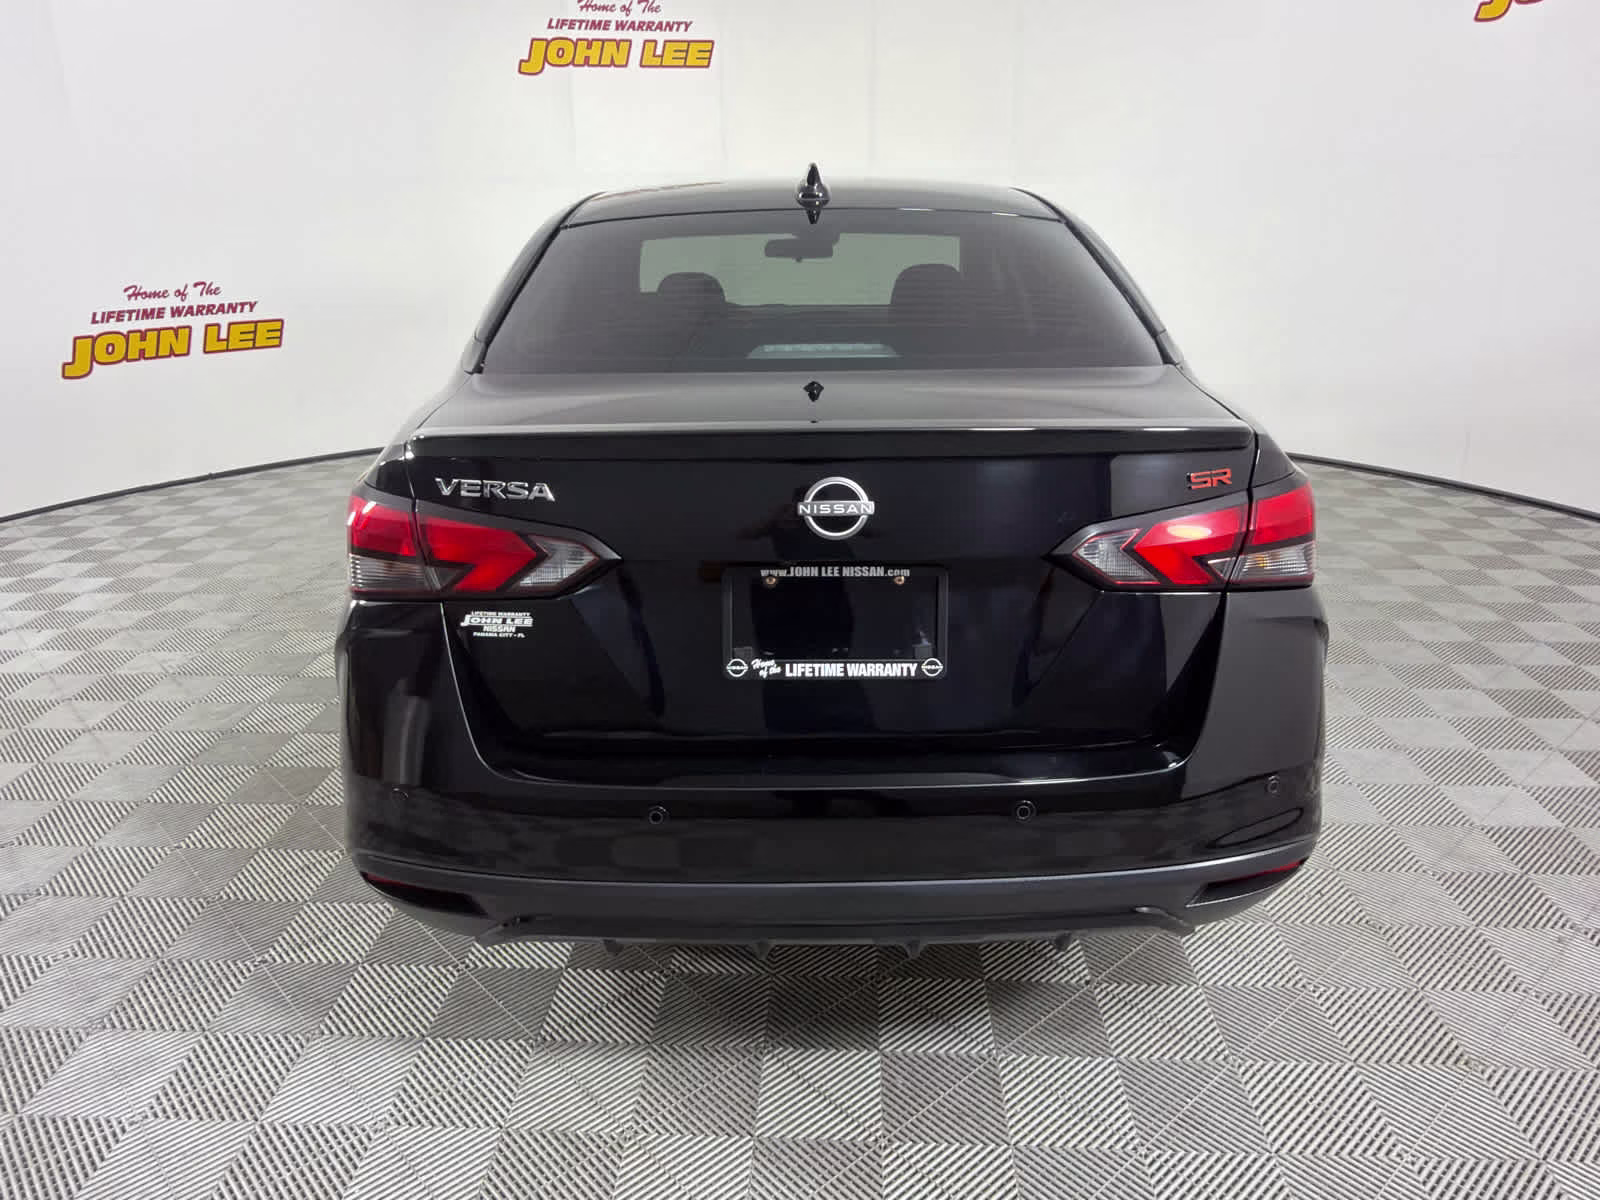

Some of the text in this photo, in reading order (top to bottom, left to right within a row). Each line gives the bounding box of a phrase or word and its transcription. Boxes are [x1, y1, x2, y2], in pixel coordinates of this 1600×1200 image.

[577, 0, 661, 16] Home of The
[547, 18, 693, 32] LIFETIME WARRANTY
[518, 37, 714, 76] JOHN LEE
[123, 281, 221, 301] Home of The
[91, 301, 257, 324] LIFETIME WARRANTY
[62, 318, 284, 379] JOHN LEE
[1188, 468, 1232, 490] SR
[435, 478, 555, 501] VERSA
[799, 503, 873, 515] NISSAN
[821, 566, 840, 577] LEE
[460, 614, 533, 627] JOHN LEE
[483, 625, 516, 633] NISSAN
[785, 663, 844, 677] LIFETIME
[847, 663, 918, 677] WARRANTY
